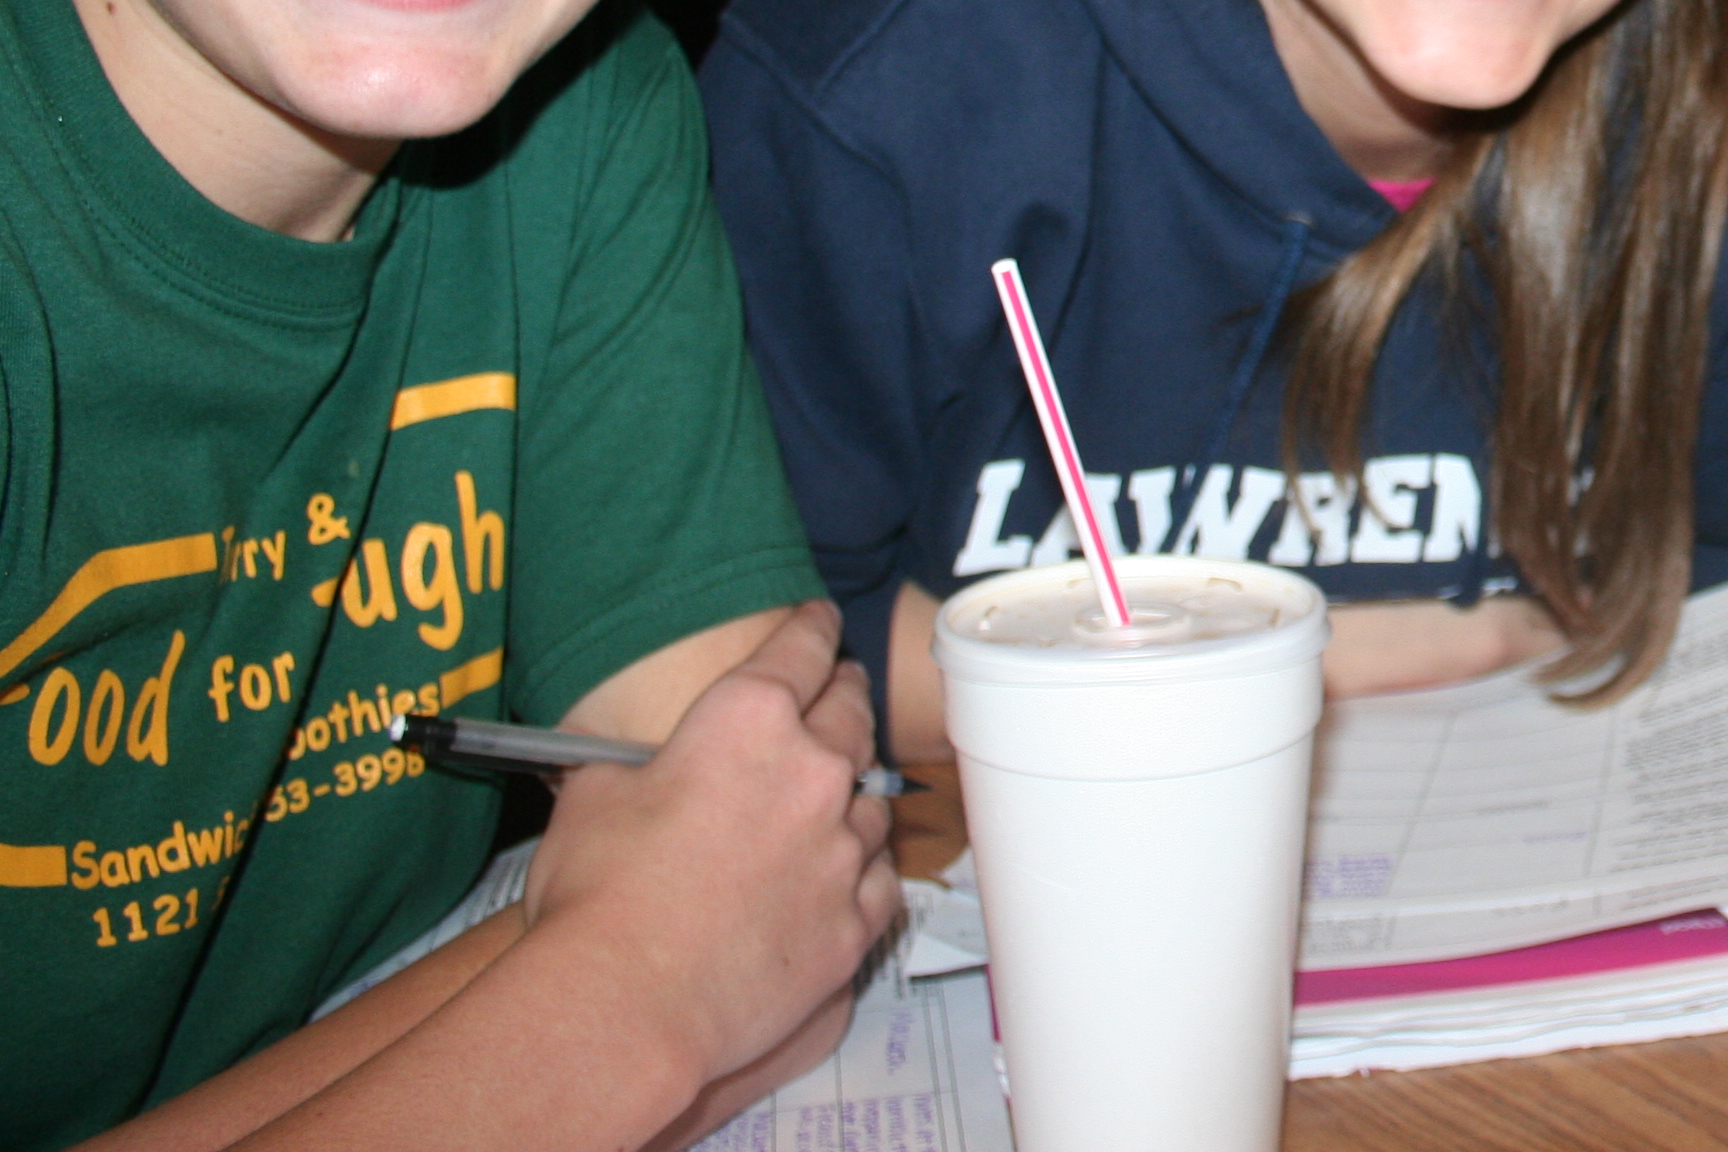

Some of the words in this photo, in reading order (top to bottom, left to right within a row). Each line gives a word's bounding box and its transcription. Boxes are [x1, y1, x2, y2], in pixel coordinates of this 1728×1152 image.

[306, 493, 351, 545] &
[311, 469, 505, 651] ugh
[0, 630, 186, 766] ood
[208, 653, 295, 722] for
[92, 888, 199, 947] 1121
